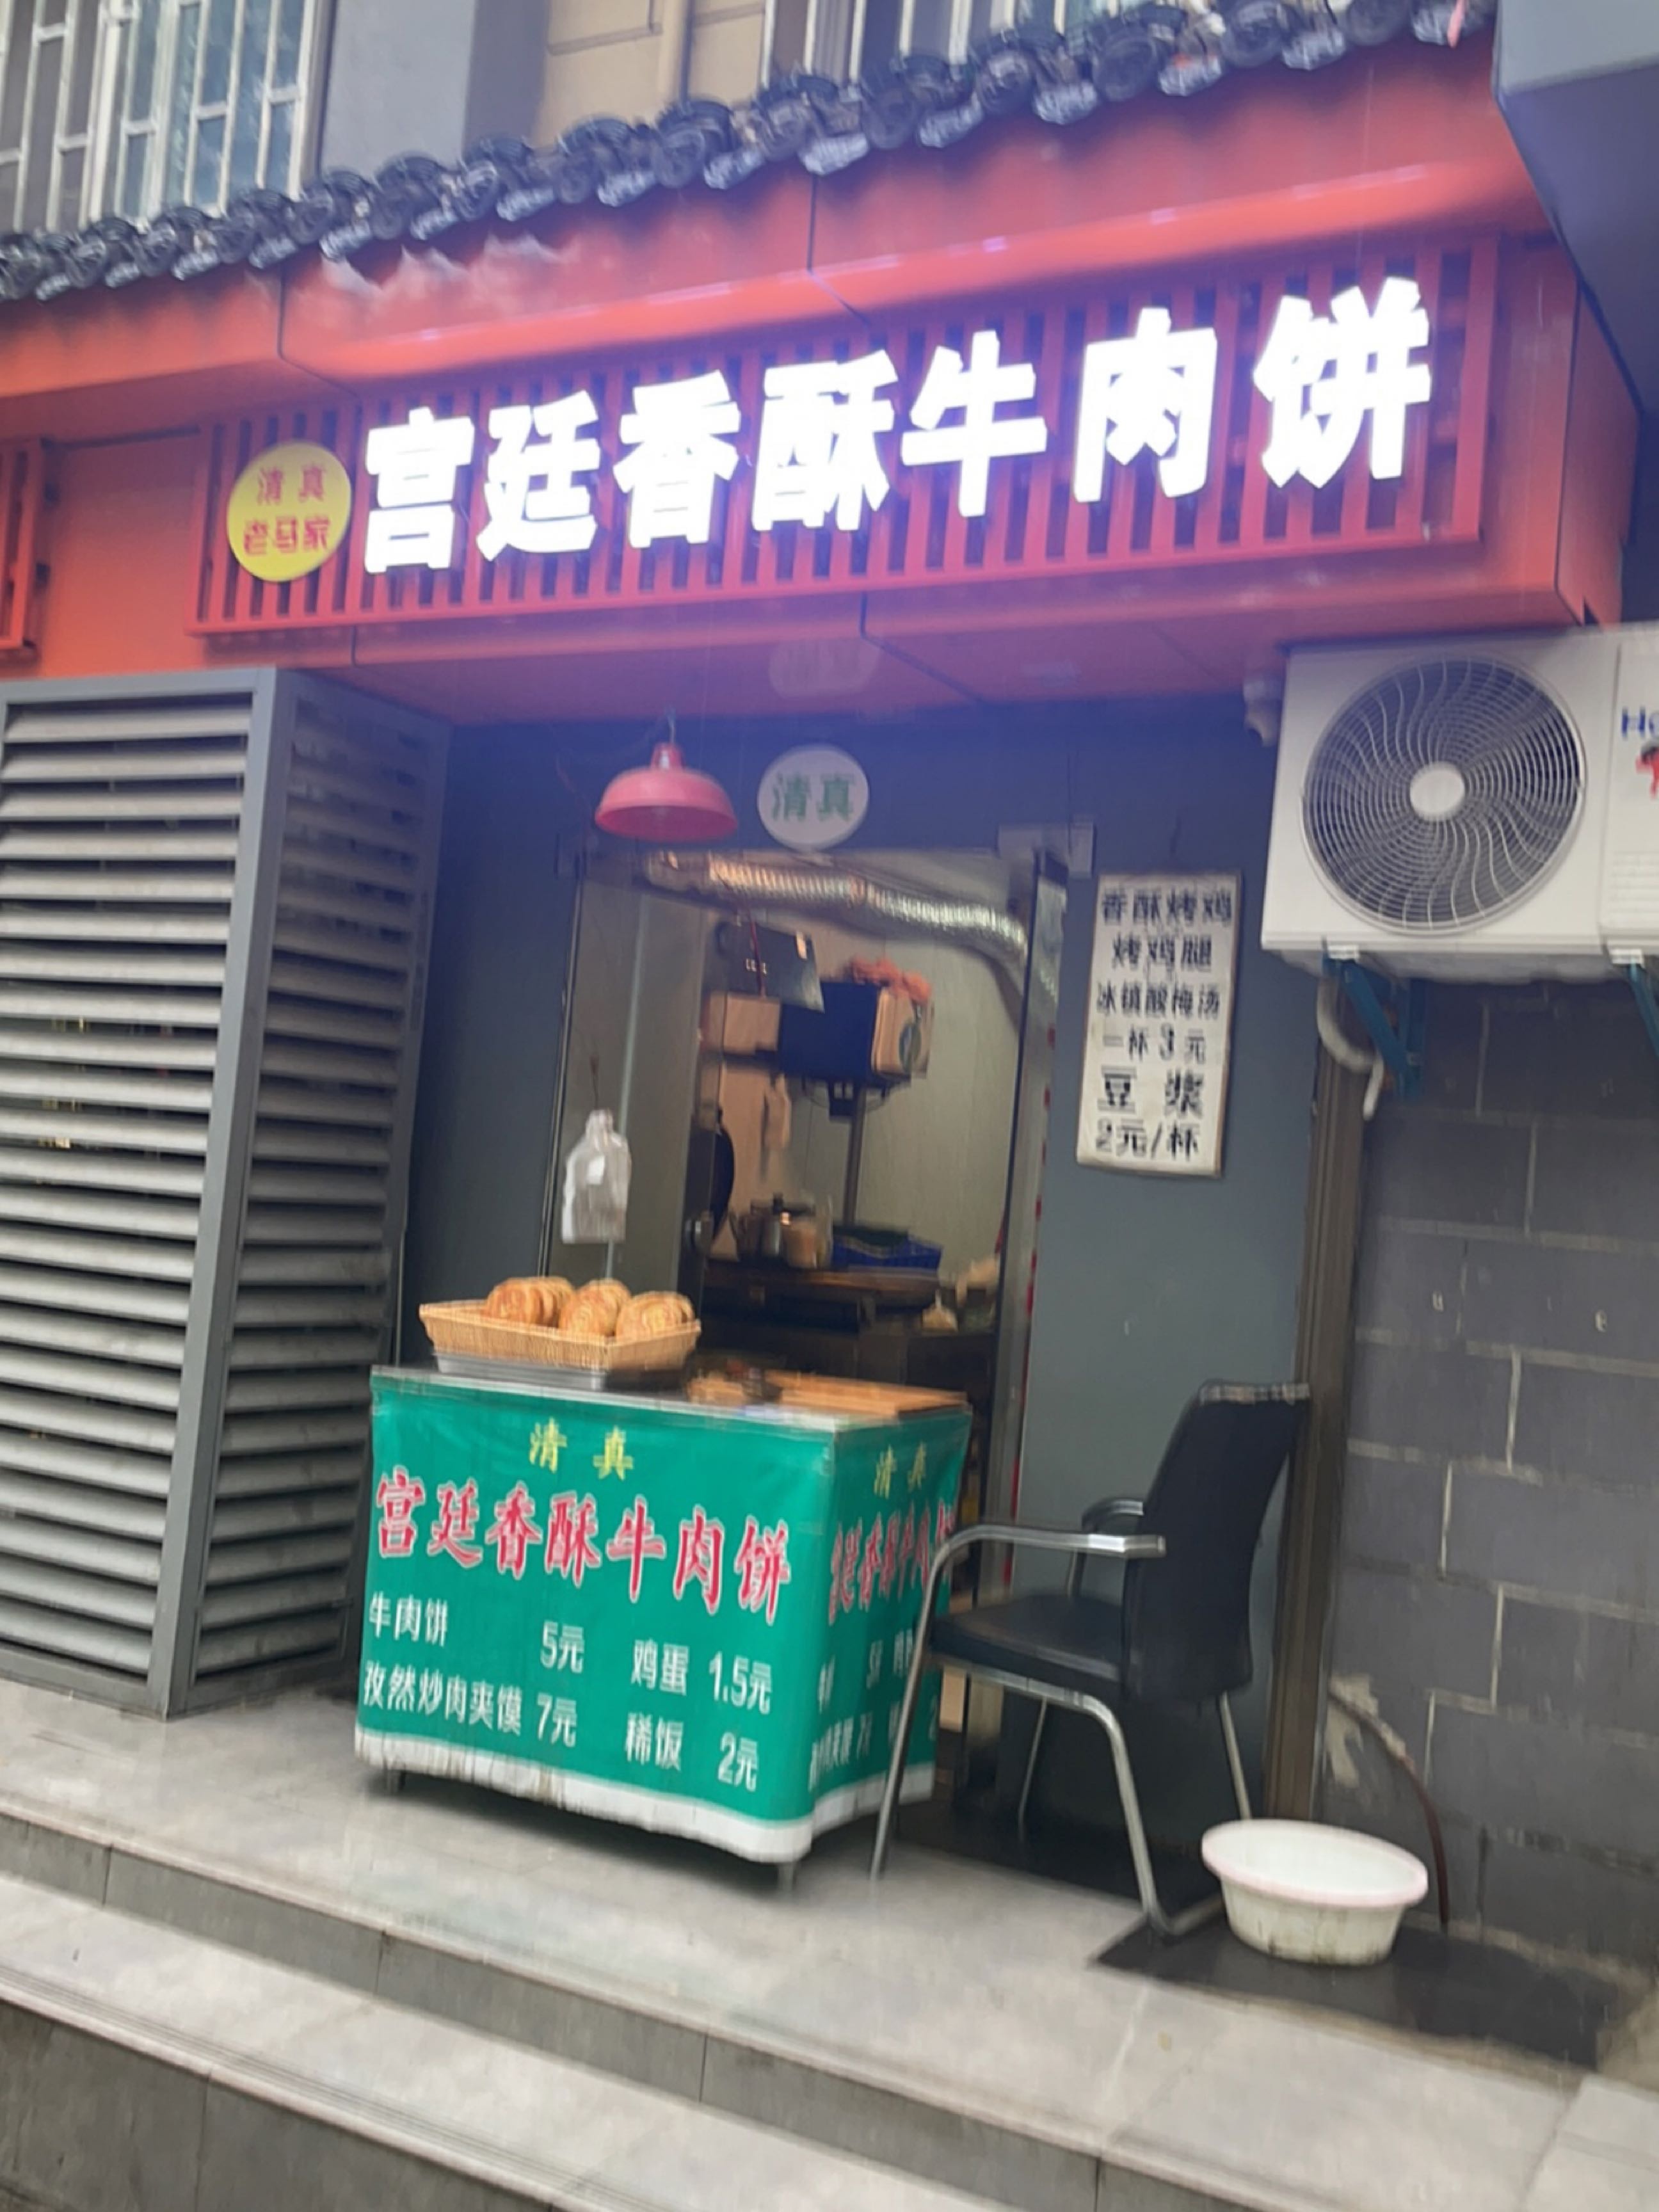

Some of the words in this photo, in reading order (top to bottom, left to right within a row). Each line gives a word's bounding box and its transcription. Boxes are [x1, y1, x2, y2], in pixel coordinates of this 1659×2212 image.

[364, 276, 1431, 574] 宫廷香酥牛肉饼
[771, 772, 855, 822] 清真
[1102, 888, 1231, 926] 香酥烤鸡
[1112, 933, 1212, 972] 烤鸡腿
[1096, 981, 1220, 1019] 冰镇酸梅汤
[1097, 1066, 1203, 1118] 豆浆
[1096, 1118, 1200, 1161] 2元/杯
[529, 1417, 634, 1482] 清真
[375, 1464, 791, 1626] 宫廷香酥牛肉饼
[369, 1591, 448, 1647] 牛肉饼
[540, 1620, 585, 1674] 5元
[630, 1638, 689, 1696] 鸡蛋
[709, 1651, 772, 1715] 1.5元
[364, 1660, 522, 1736] 孜然炒肉夹馍
[536, 1692, 577, 1748] 7元
[625, 1712, 696, 1772] 稀饭
[717, 1731, 758, 1792] 2元
